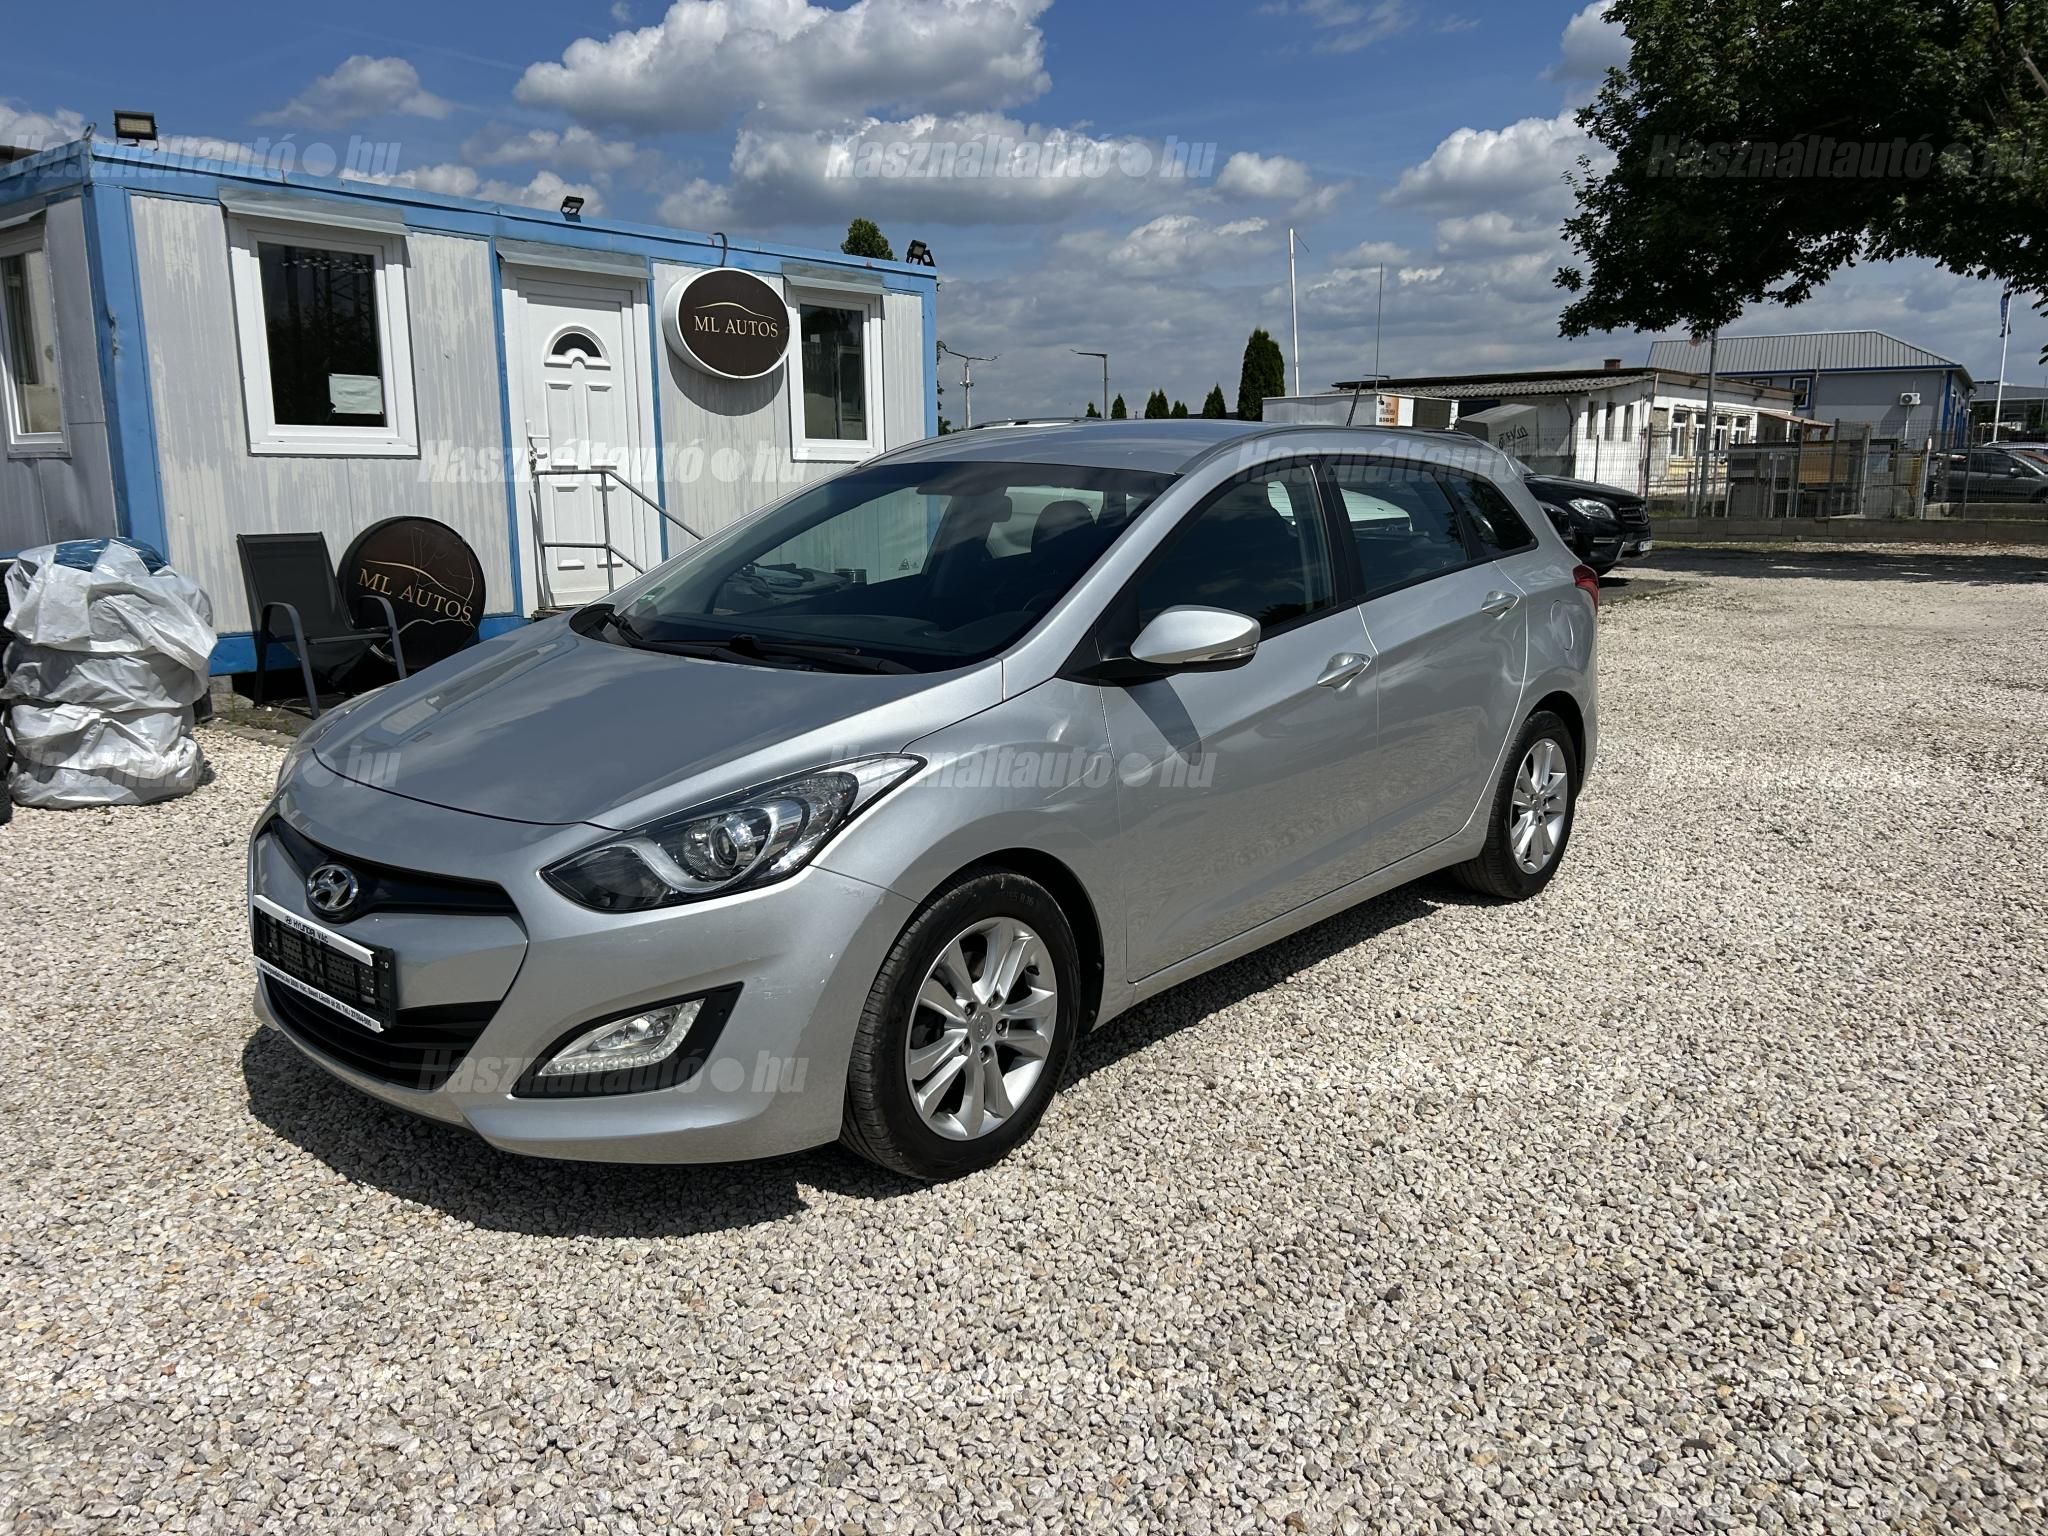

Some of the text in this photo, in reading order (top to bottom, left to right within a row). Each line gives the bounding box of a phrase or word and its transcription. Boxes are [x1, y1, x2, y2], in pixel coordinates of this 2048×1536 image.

[694, 316, 779, 338] ML AUTOS
[357, 568, 473, 622] ML AUTOS
